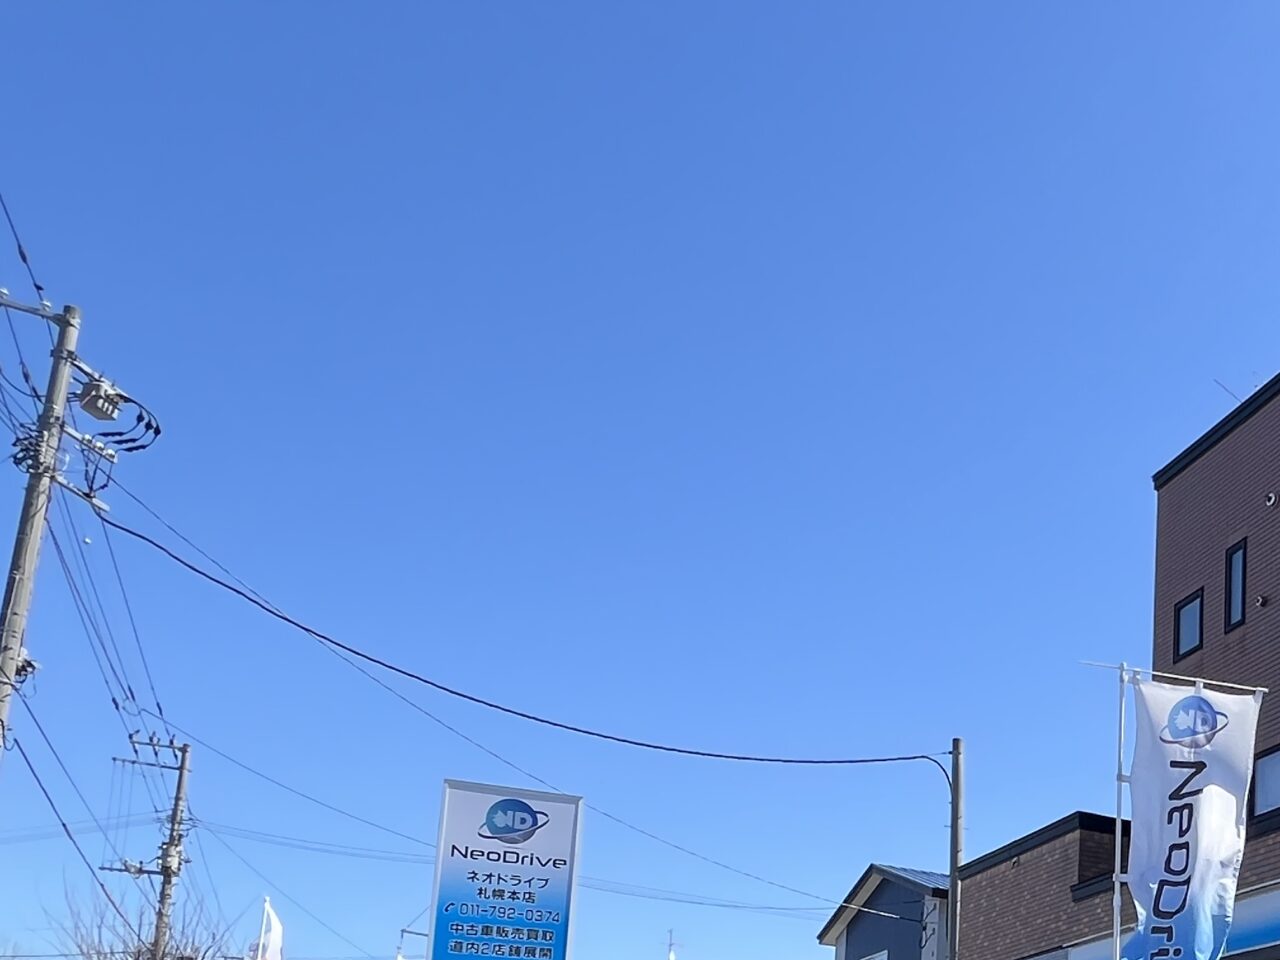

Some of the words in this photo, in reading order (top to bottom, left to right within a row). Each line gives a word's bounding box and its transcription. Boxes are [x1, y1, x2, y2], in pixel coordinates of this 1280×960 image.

[451, 844, 567, 869] NeoDrive
[467, 870, 550, 889] ネオドライブ
[477, 886, 536, 903] 札幌本店
[459, 903, 560, 923] 011-792-0374
[449, 923, 555, 942] 中古車販売買取
[448, 940, 553, 960] 道内2店舗展開
